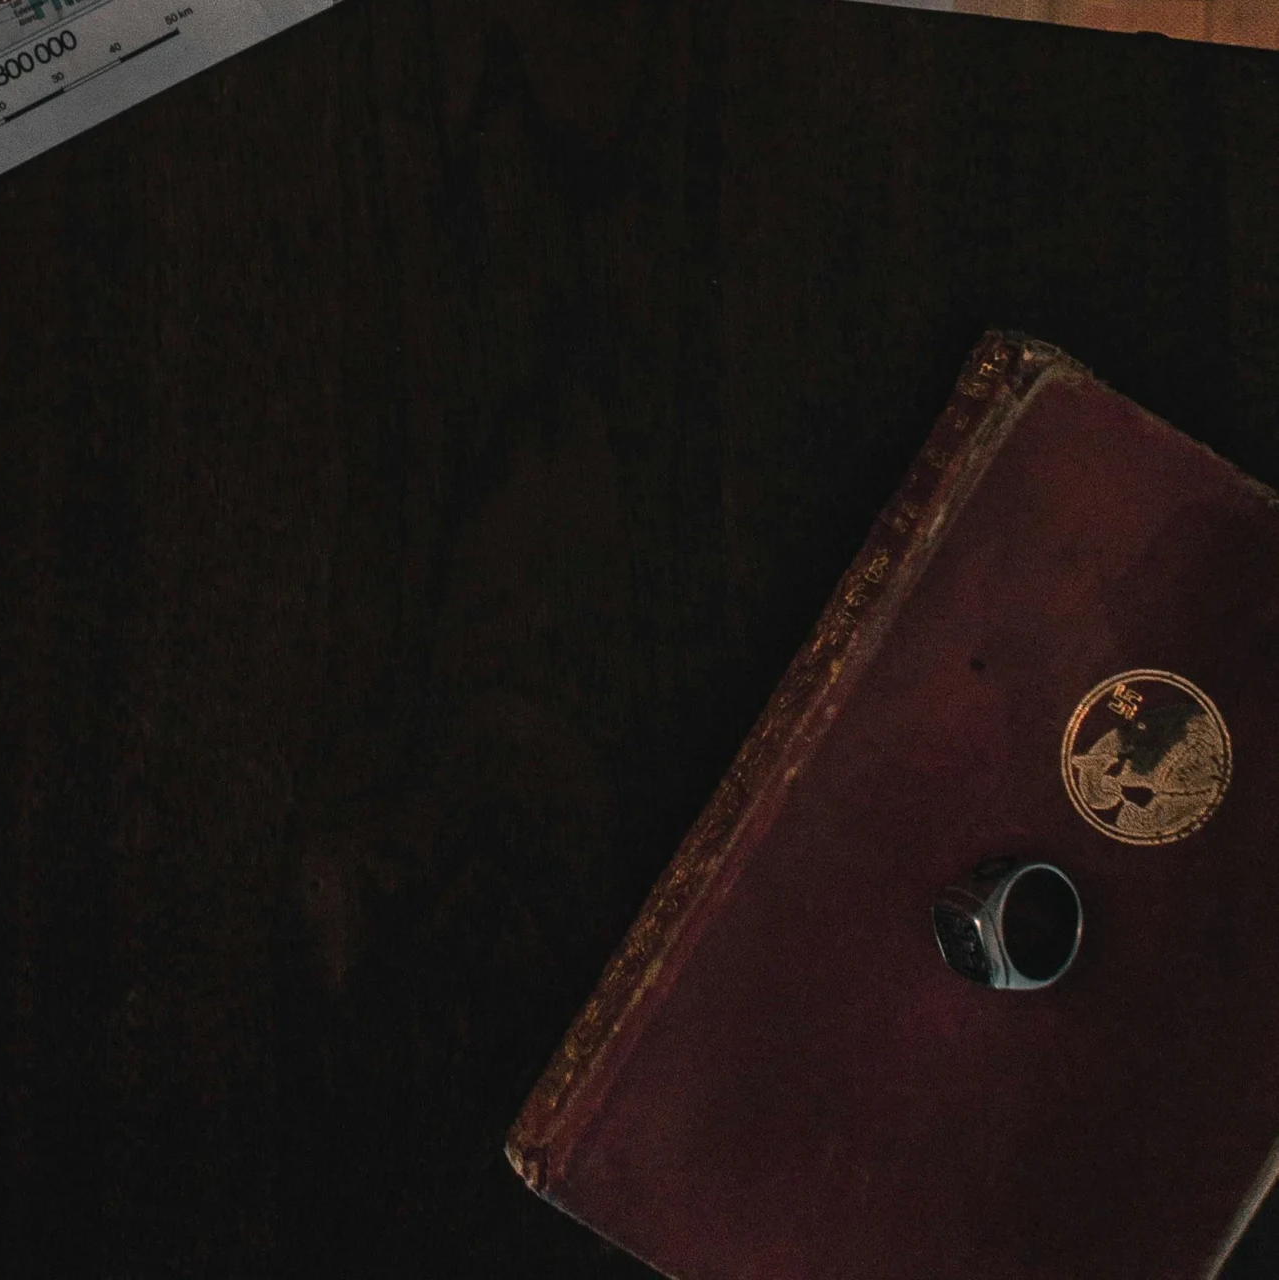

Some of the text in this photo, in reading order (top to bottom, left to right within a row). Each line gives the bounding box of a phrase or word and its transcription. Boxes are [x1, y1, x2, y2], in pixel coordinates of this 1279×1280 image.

[179, 5, 194, 20] km
[108, 41, 122, 55] 40
[51, 71, 65, 85] 30
